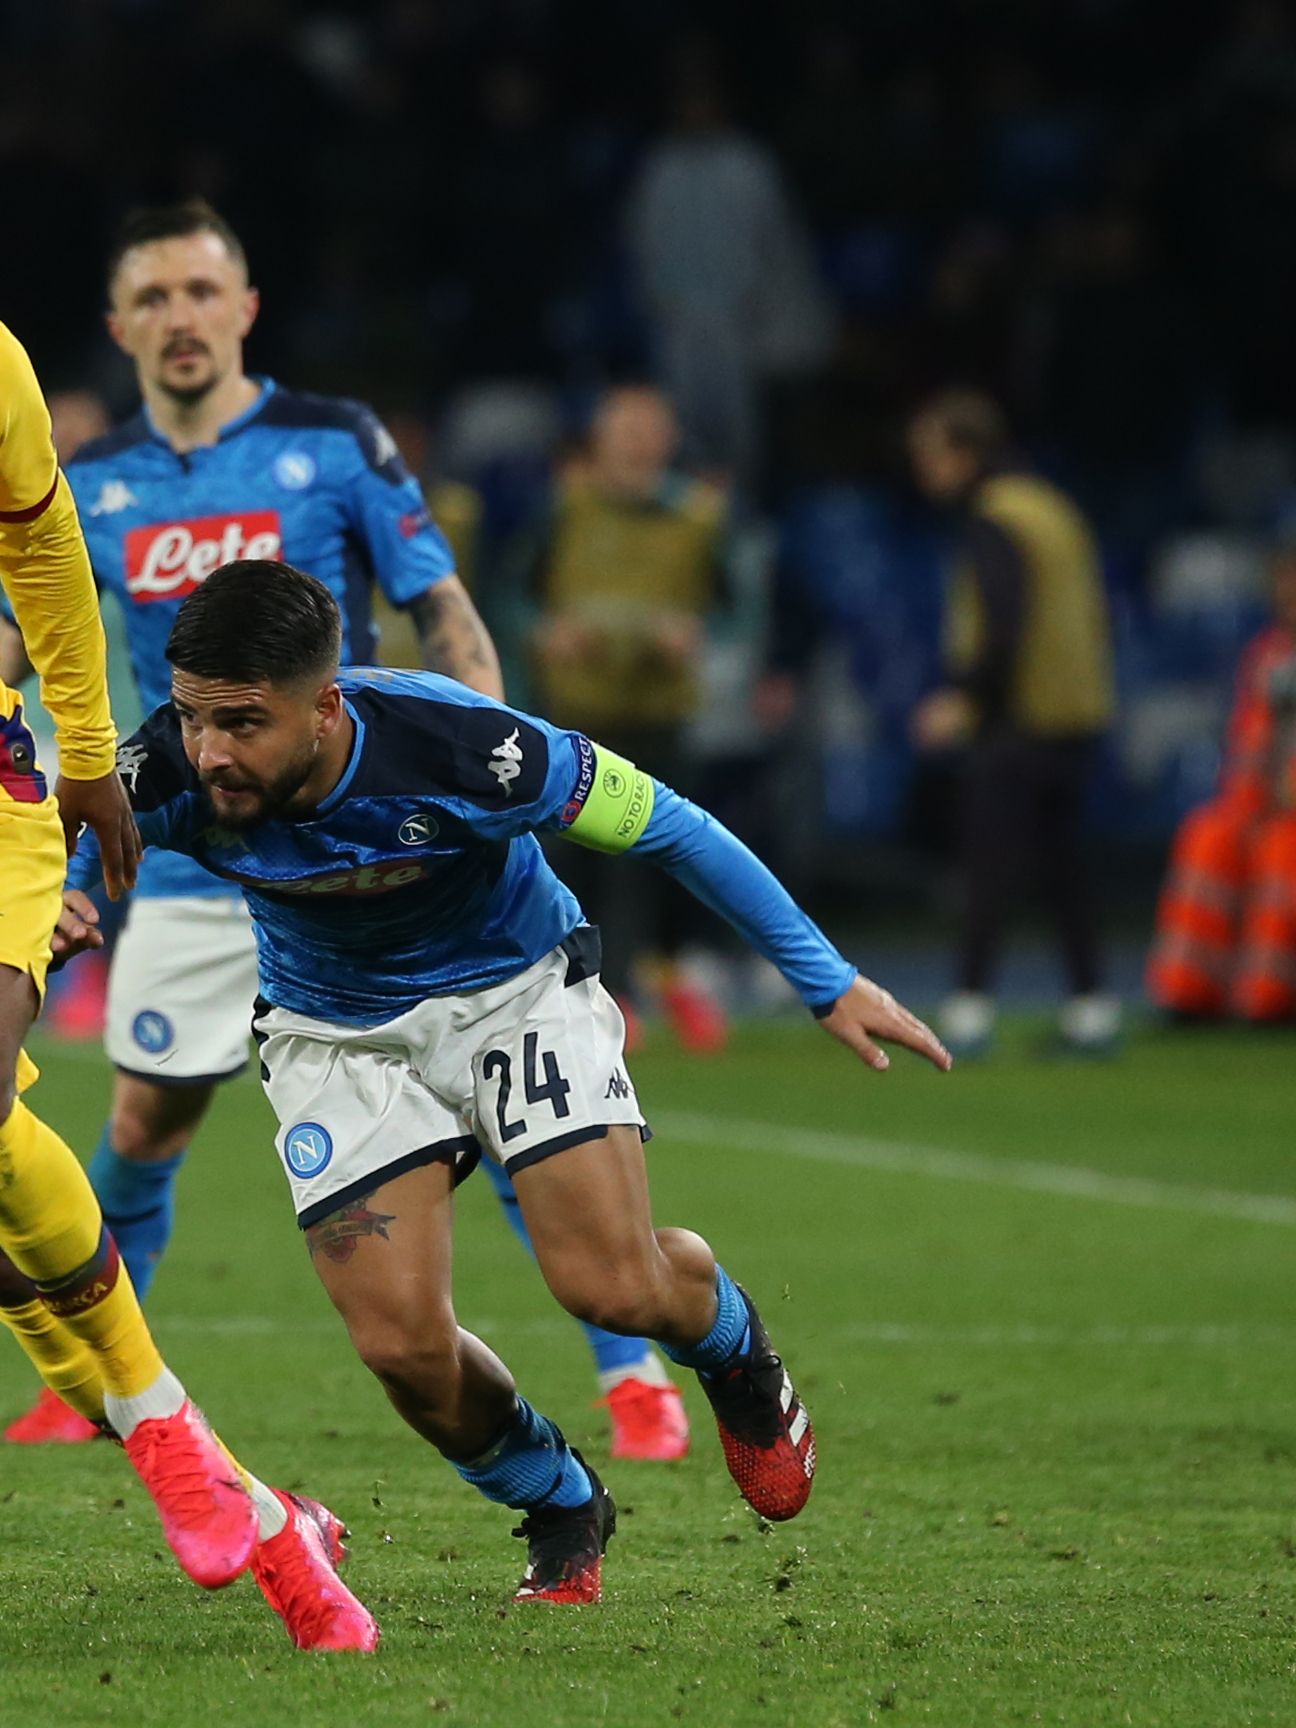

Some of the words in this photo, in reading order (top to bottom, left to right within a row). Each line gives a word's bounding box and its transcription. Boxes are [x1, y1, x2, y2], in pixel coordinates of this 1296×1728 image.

[127, 522, 281, 593] Lete
[575, 736, 592, 801] RESPECT
[617, 819, 634, 838] NO
[629, 801, 642, 818] TO
[483, 1032, 570, 1143] 24
[294, 1135, 318, 1166] N
